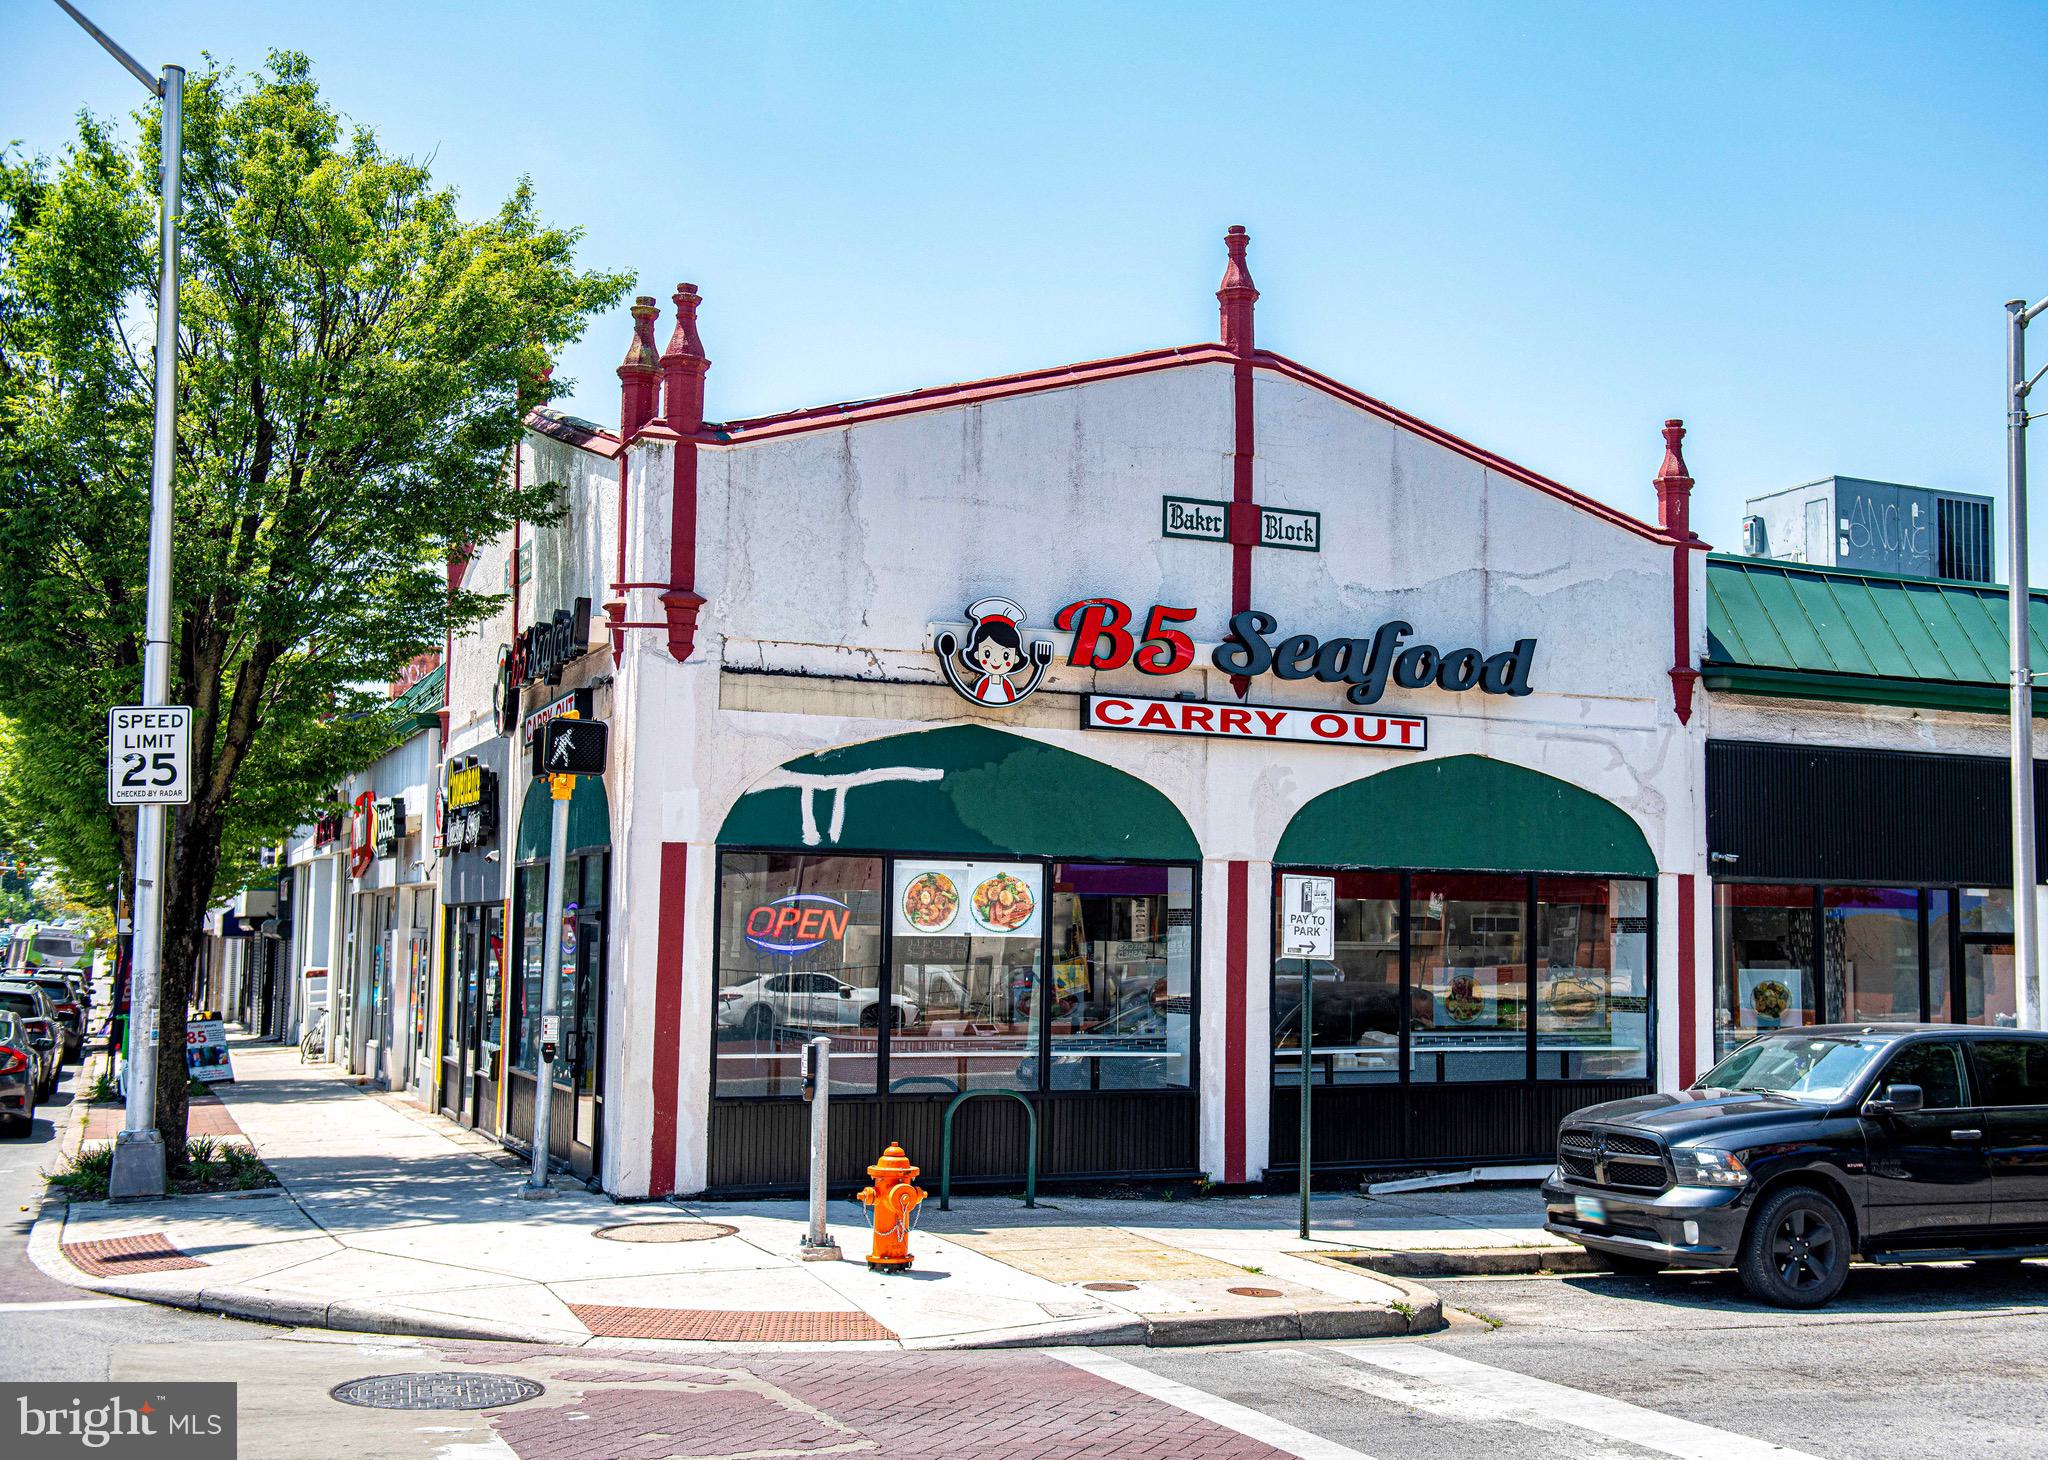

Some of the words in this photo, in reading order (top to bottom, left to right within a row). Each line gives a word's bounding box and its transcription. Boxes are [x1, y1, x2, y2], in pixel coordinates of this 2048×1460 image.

[1168, 503, 1222, 532] Baker
[1264, 514, 1314, 542] Block
[1053, 598, 1199, 676] B5
[1211, 609, 1536, 705] Seafood
[118, 714, 183, 729] SPEED
[1094, 699, 1288, 736] CARRY
[1310, 714, 1421, 743] OUT
[124, 734, 175, 749] LIMIT
[122, 753, 178, 787] 25
[117, 790, 147, 798] CHECKED
[148, 790, 158, 798] BY
[160, 789, 183, 797] RADAR
[746, 906, 851, 940] OPEN
[1290, 914, 1309, 925] PAY
[1311, 915, 1326, 926] TO
[1293, 926, 1321, 937] PARK
